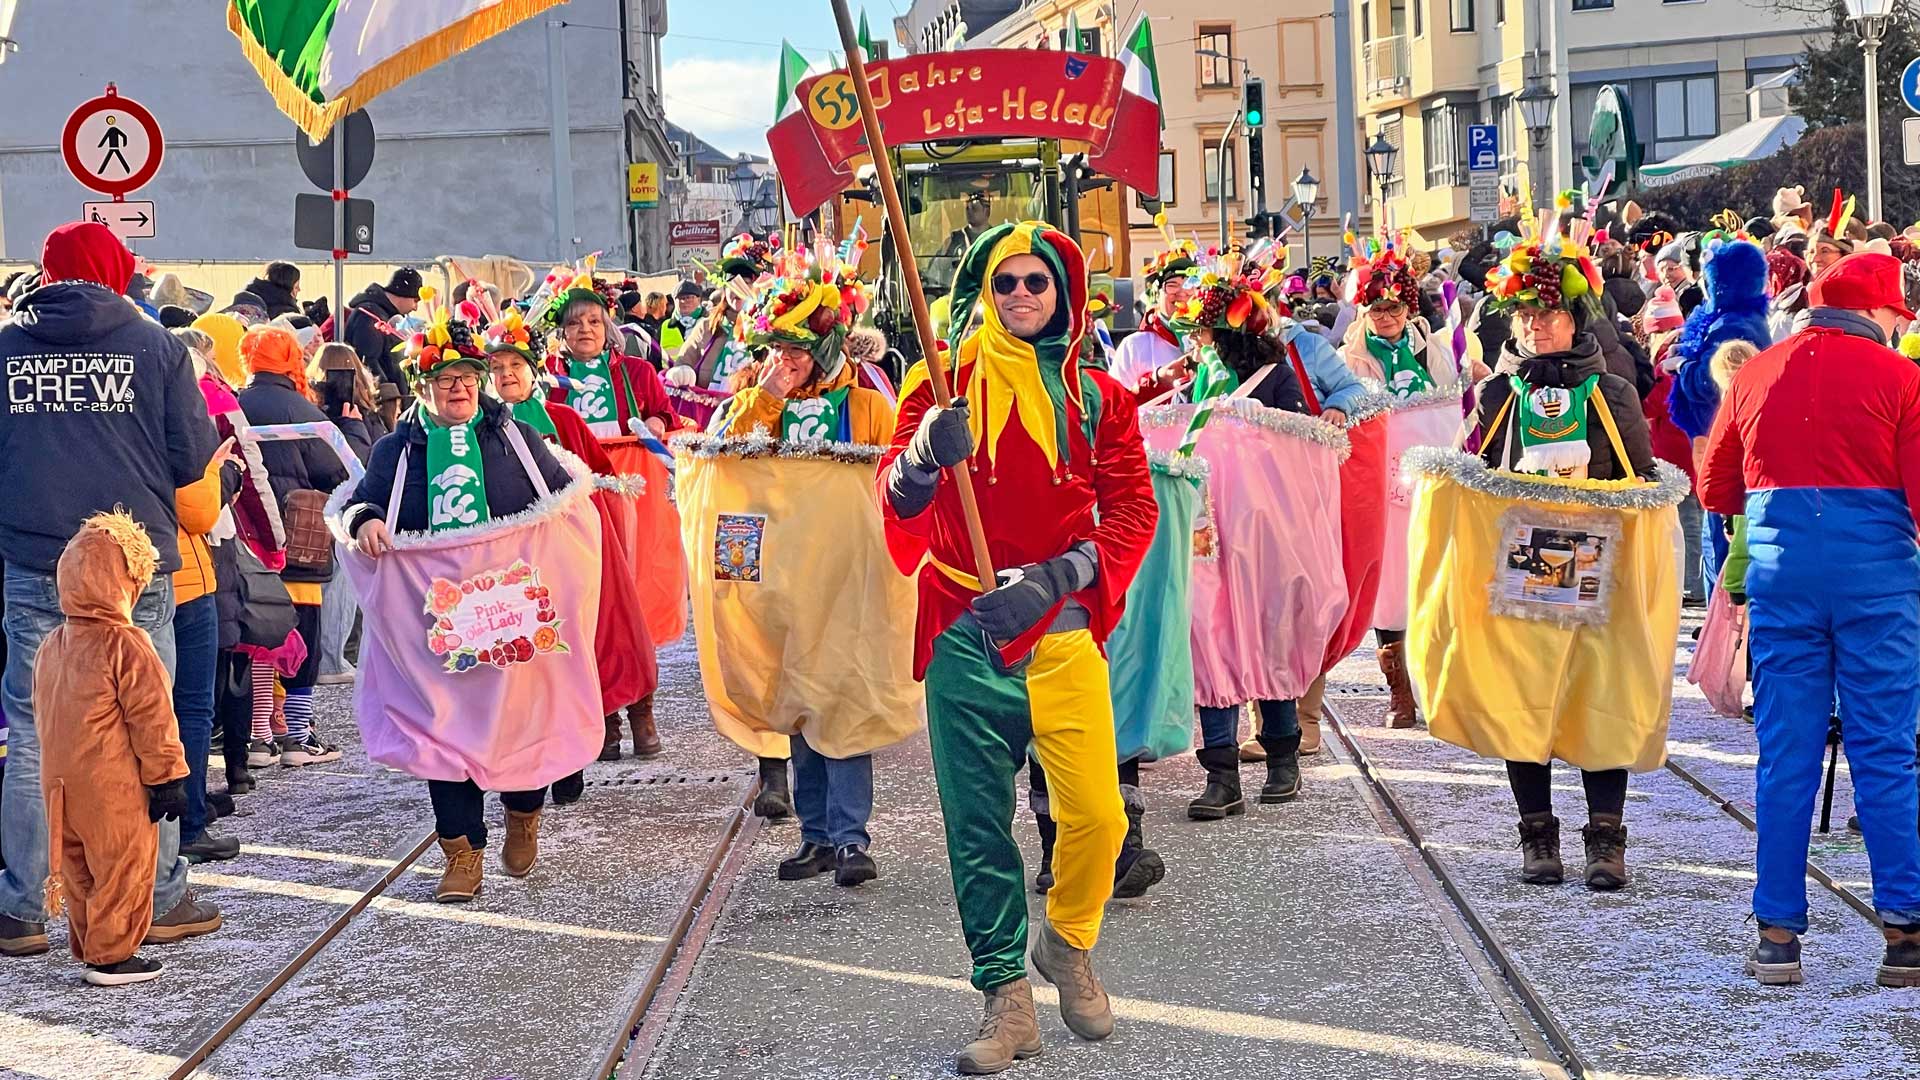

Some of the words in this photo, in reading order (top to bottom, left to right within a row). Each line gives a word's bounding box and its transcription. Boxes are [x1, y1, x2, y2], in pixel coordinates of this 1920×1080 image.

[815, 80, 858, 124] 55
[921, 86, 1115, 135] Lefa-Helau
[1472, 128, 1486, 147] P
[631, 186, 657, 194] LOTTO
[672, 224, 717, 238] Geuthner
[7, 359, 68, 376] CAMP
[72, 359, 134, 374] DAVID
[8, 374, 133, 404] CREW
[10, 403, 38, 415] REG.
[43, 402, 69, 412] TM.
[449, 423, 470, 457] lub
